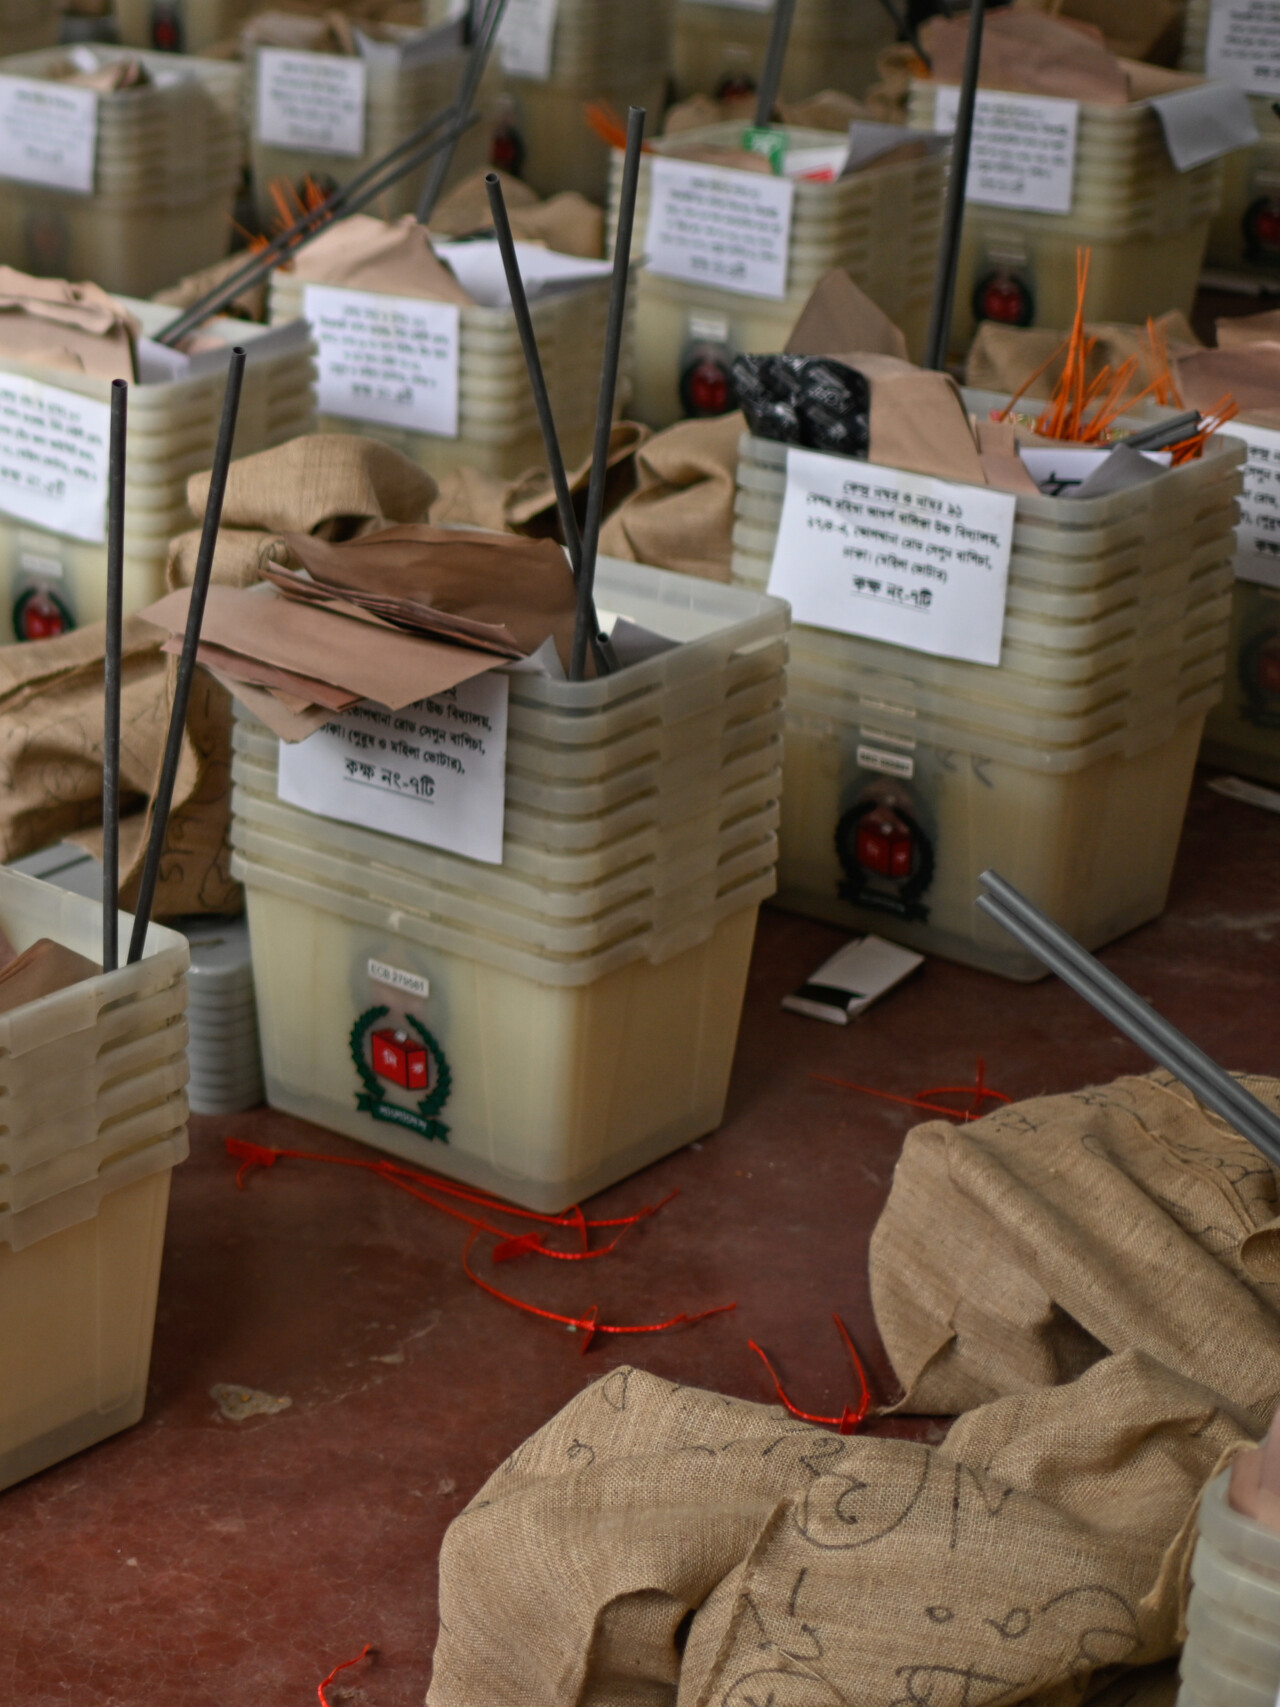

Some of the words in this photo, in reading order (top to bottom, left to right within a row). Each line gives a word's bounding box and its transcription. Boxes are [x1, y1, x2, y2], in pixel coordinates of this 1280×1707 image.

[345, 758, 374, 780] কক্ষ
[390, 740, 420, 759] মহিলা
[423, 751, 466, 775] ভোটার),
